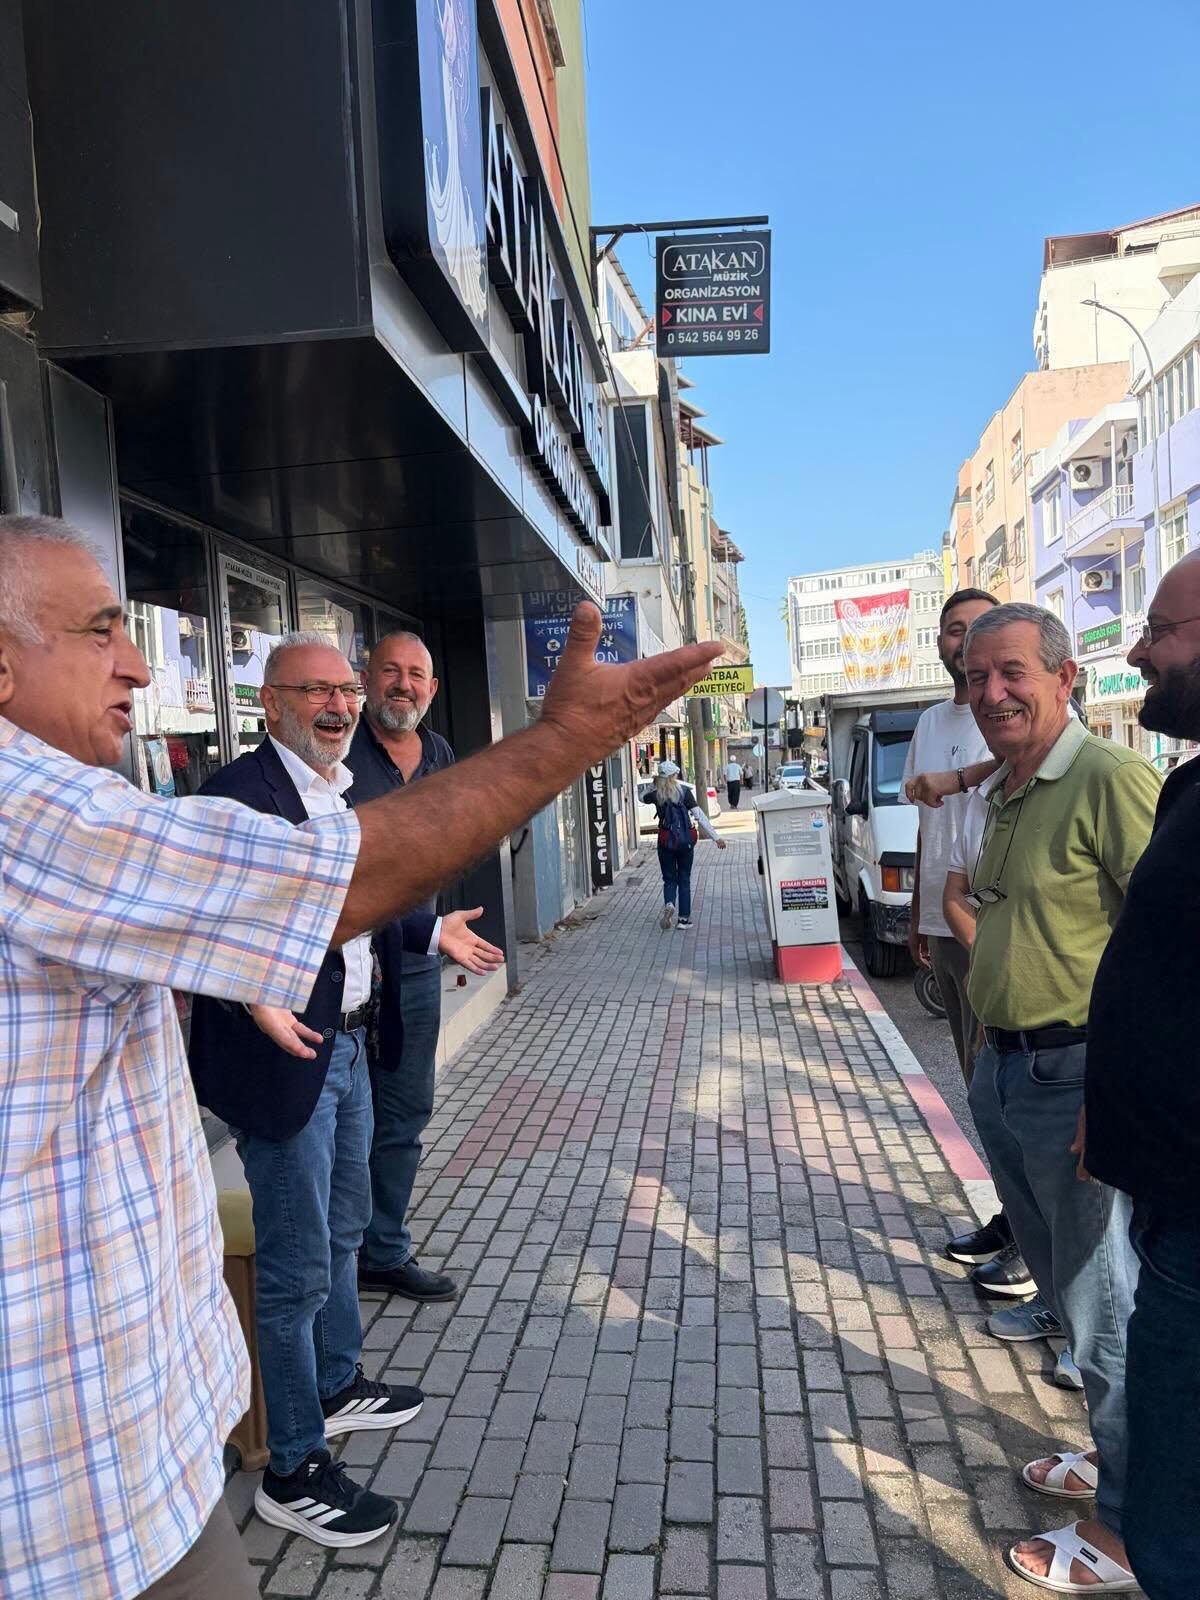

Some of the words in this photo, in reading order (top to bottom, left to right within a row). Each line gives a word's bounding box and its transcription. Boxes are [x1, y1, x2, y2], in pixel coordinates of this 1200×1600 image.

[485, 86, 582, 433] ATAKAN
[672, 249, 757, 273] ATAKAN
[713, 270, 749, 282] MÜZİK
[664, 285, 760, 299] ORGANİZASYON
[676, 307, 717, 323] KINA
[722, 304, 748, 321] EVİ
[667, 333, 674, 344] 0
[678, 332, 699, 343] 542
[702, 331, 723, 342] 564
[727, 330, 741, 341] 99
[745, 329, 758, 340] 26
[703, 671, 739, 682] ATBAA
